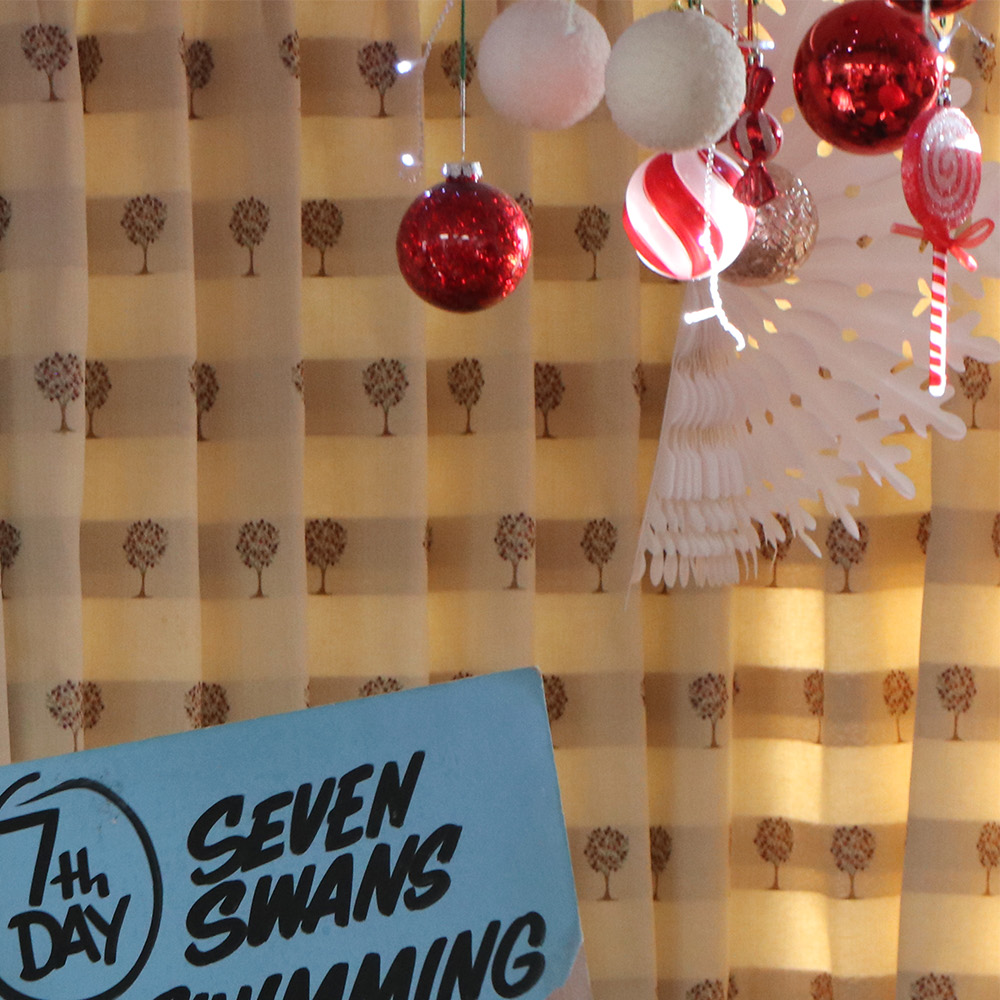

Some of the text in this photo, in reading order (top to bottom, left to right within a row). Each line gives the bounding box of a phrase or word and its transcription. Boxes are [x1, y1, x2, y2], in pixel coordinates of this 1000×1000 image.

[187, 751, 425, 885] SEVEN
[8, 894, 131, 981] DAY
[185, 824, 462, 966] SWANS
